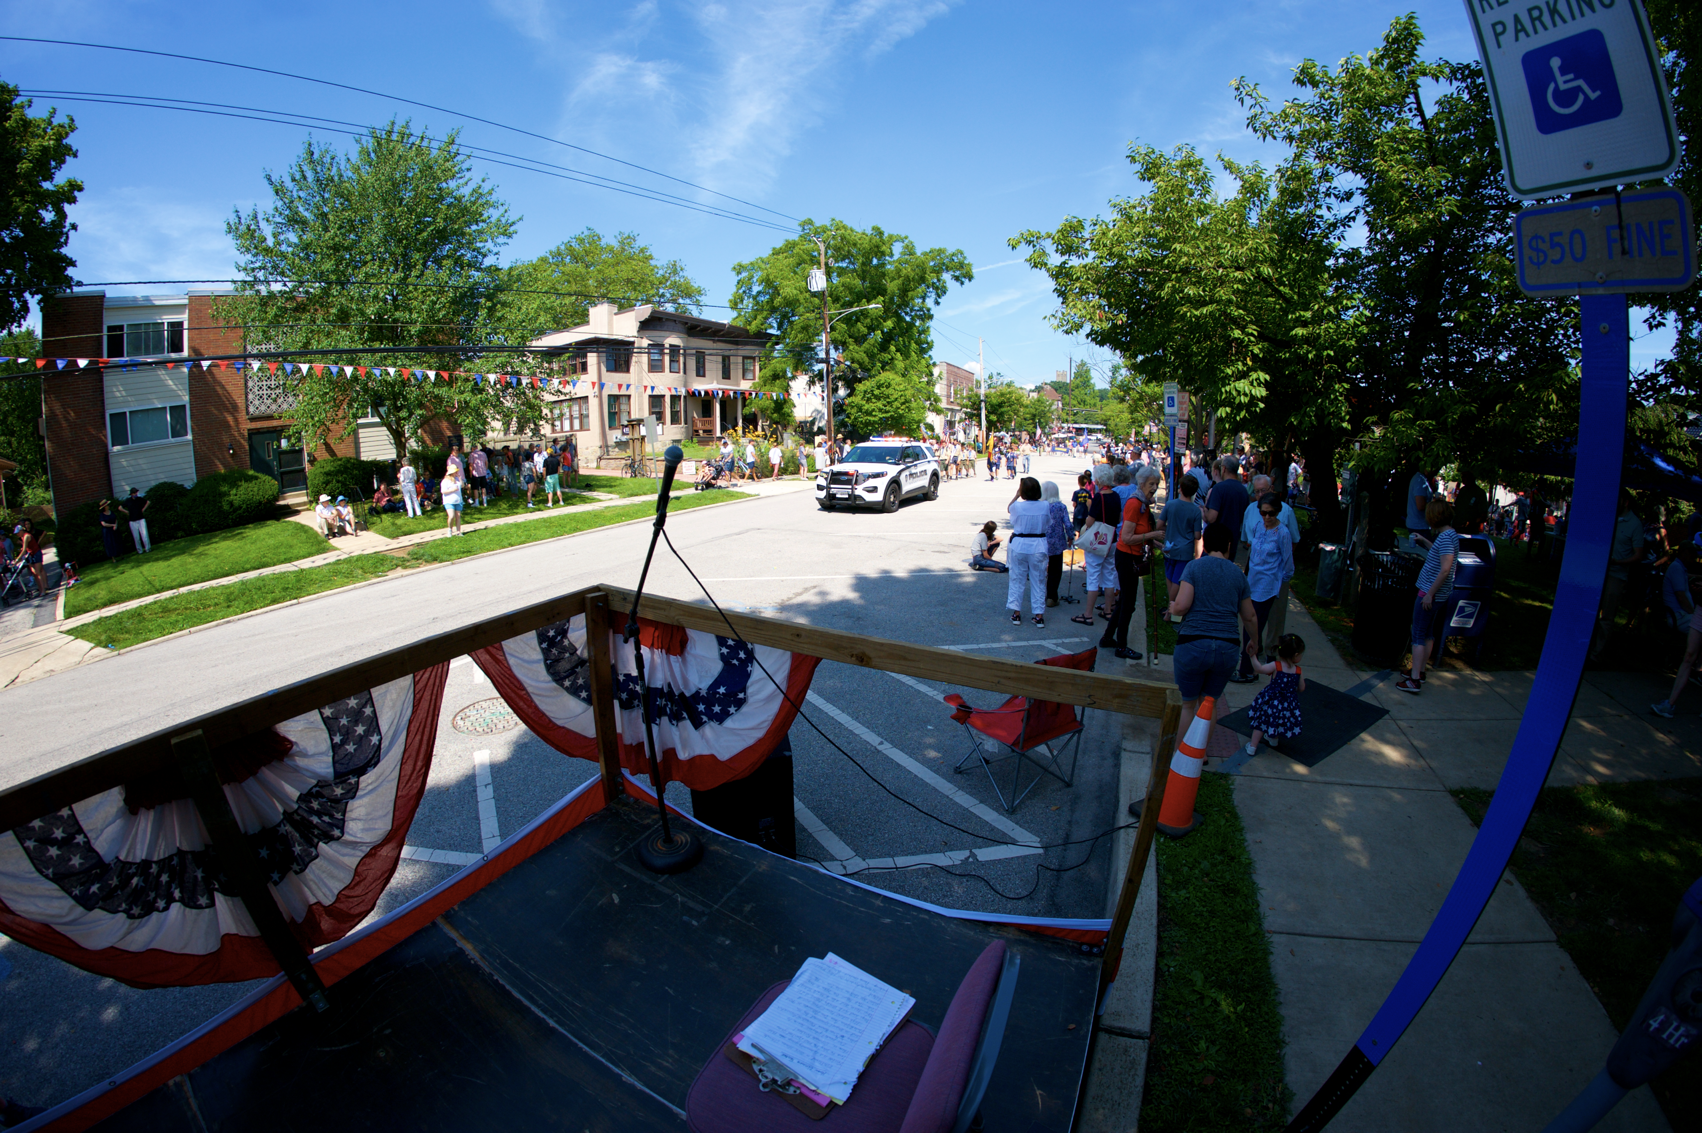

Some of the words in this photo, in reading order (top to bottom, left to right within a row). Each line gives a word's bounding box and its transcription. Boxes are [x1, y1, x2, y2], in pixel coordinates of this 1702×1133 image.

[1527, 228, 1587, 269] $50
[1606, 219, 1678, 259] FINE
[909, 469, 927, 480] POLICE
[1648, 1014, 1666, 1032] 4
[1661, 1021, 1689, 1049] Hr
